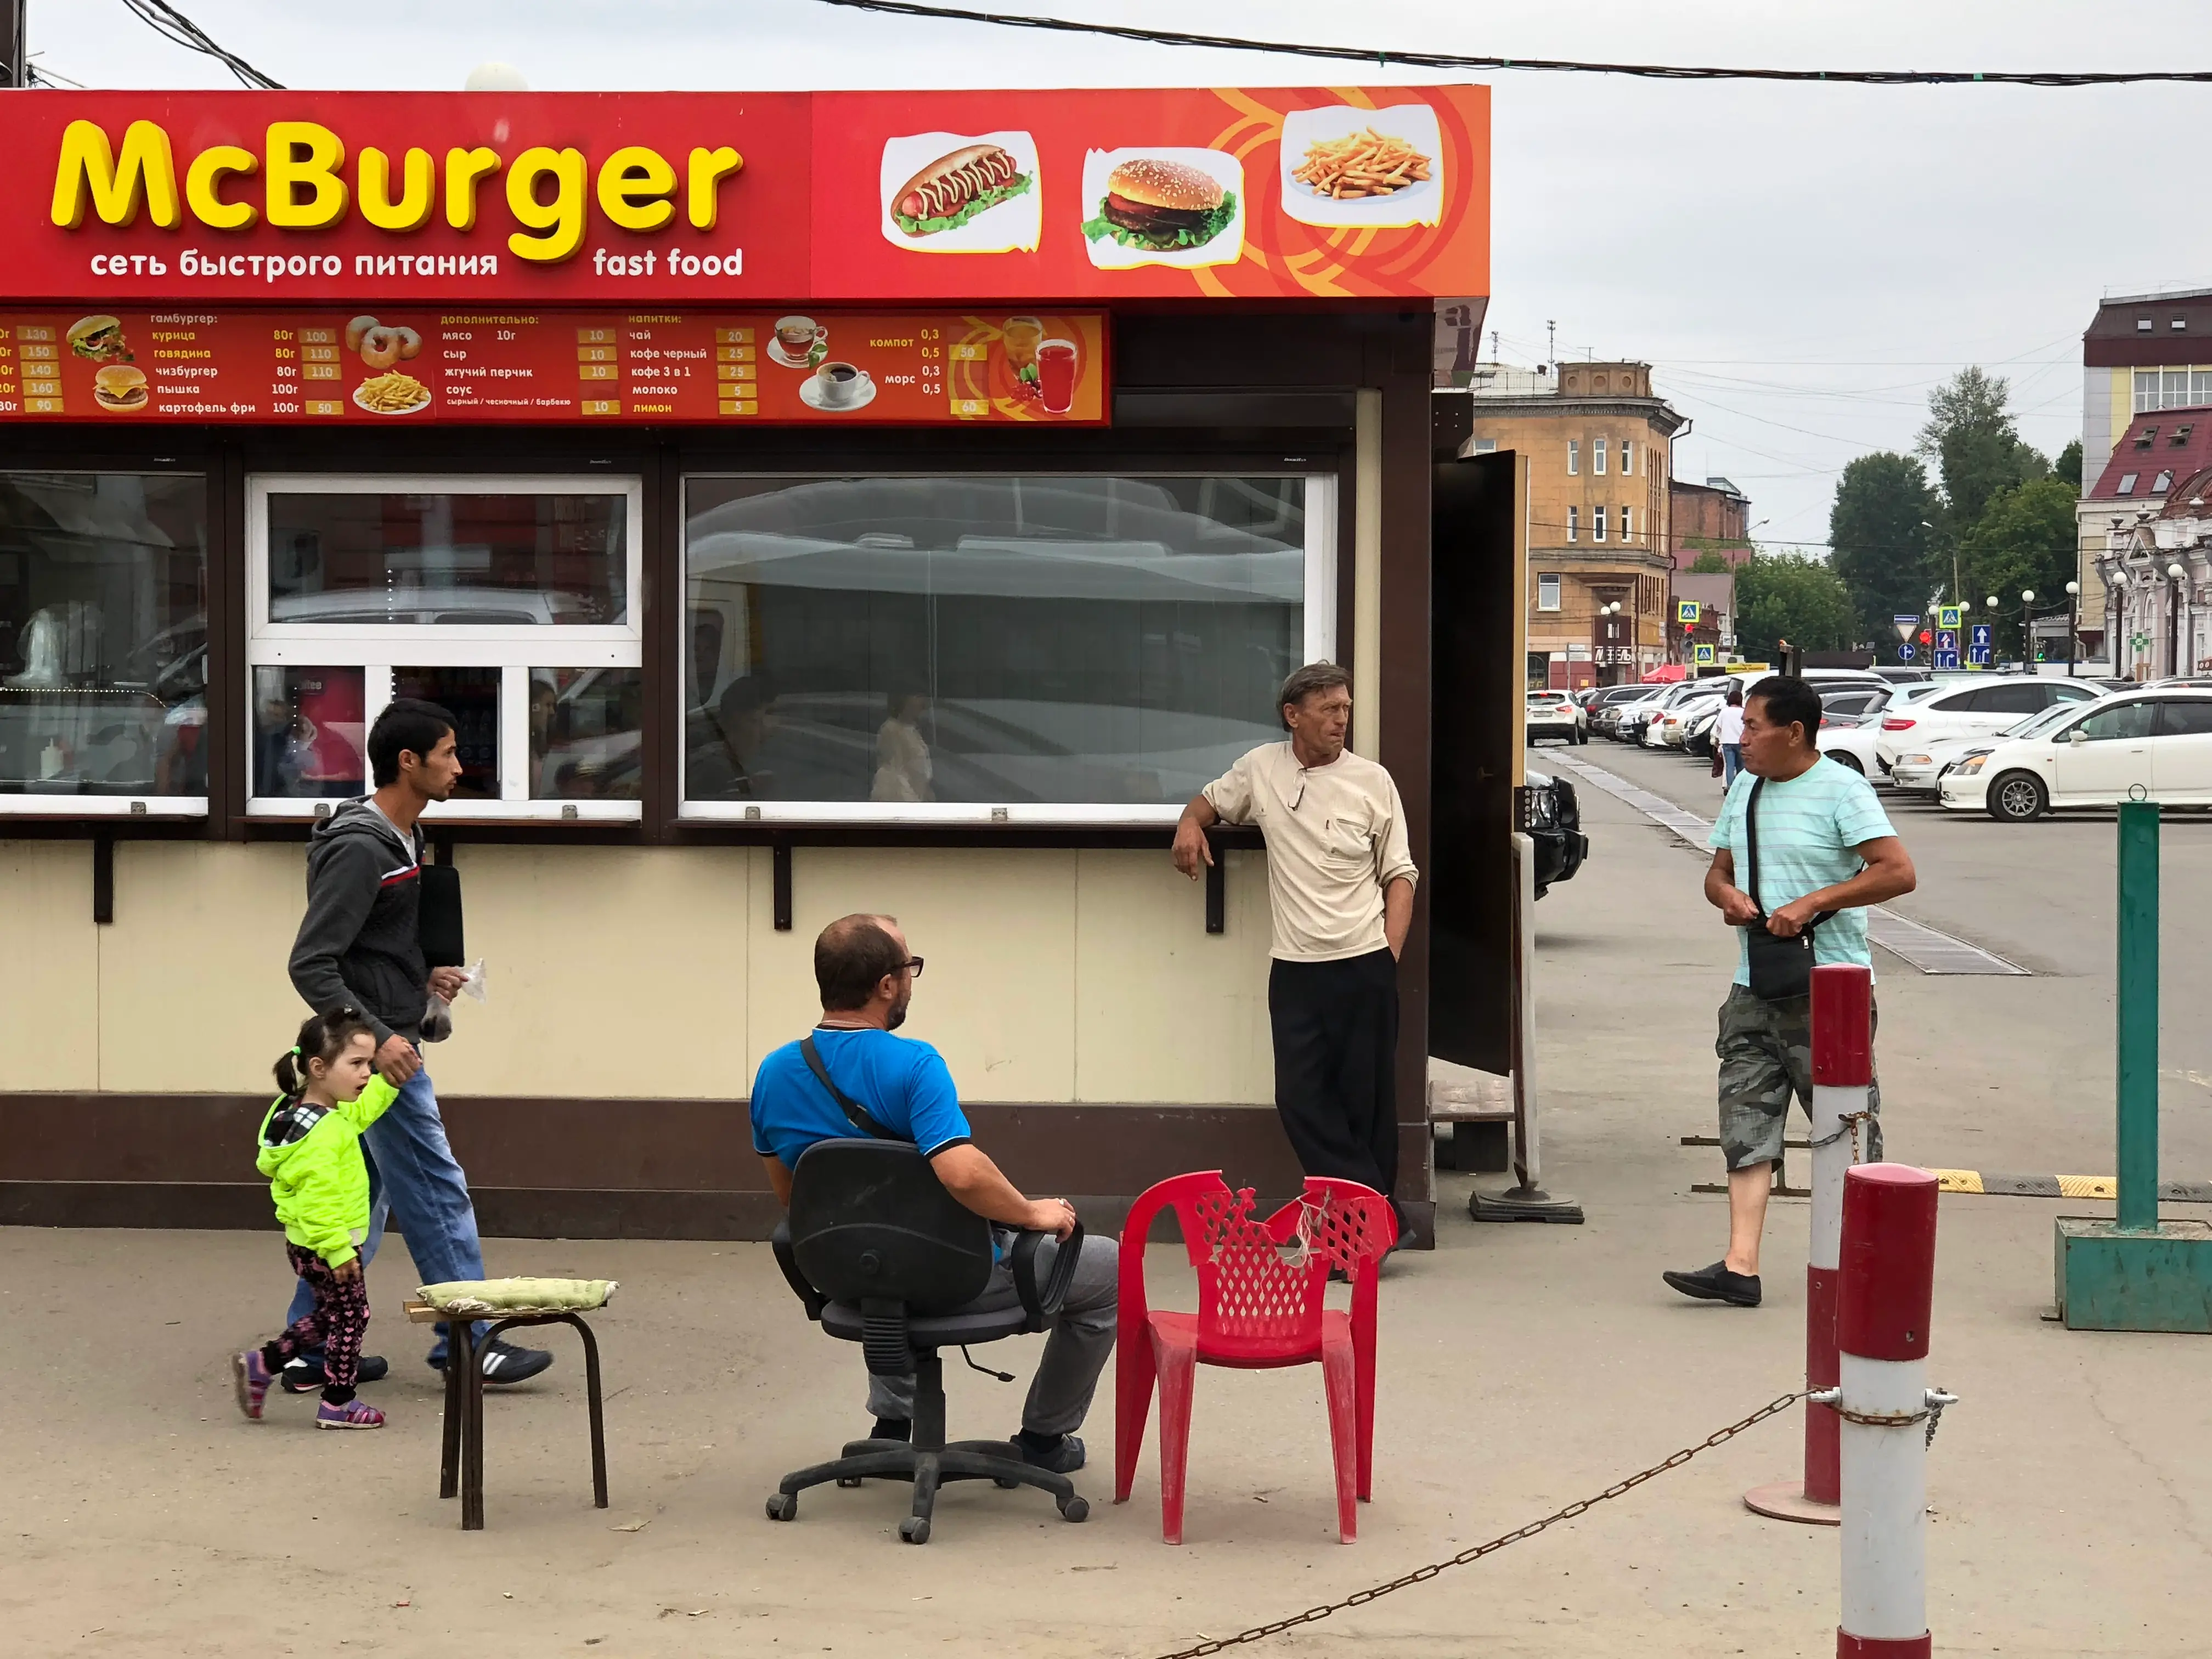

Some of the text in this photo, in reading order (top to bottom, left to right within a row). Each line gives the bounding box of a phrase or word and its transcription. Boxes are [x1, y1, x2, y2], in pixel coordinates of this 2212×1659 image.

[51, 119, 743, 263] McBurger
[91, 248, 498, 284] сеть быстрого питания
[593, 248, 743, 276] fast food
[150, 313, 218, 325] гамбургер:
[441, 316, 539, 325] дополнительно:
[629, 315, 682, 323] напитки:
[152, 330, 327, 342] курица 80г 100
[442, 330, 604, 341] мясо 10г 10
[629, 330, 743, 342] чай 20
[921, 329, 939, 341] 0,3
[870, 339, 915, 347] компот
[29, 347, 50, 357] 150
[154, 348, 332, 359] говядина 80г 110
[443, 349, 605, 361] сыр 10
[630, 348, 743, 360] кофе черный 25
[922, 347, 975, 359] 0,5 50
[30, 365, 51, 375] 140
[155, 365, 333, 378] чизбургер 80г 110
[445, 366, 606, 379] жгучий перчик 10
[631, 366, 744, 379] кофе 3 в 1 25
[922, 365, 940, 377] 0,3
[884, 375, 916, 386] морс
[31, 383, 53, 393] 160
[157, 383, 298, 394] пышка 100г
[446, 386, 472, 396] соус
[632, 386, 741, 396] молоко 5
[922, 383, 941, 395] 0,5
[159, 402, 332, 415] картофель фри 100г 50
[447, 398, 478, 406] сырный
[536, 398, 571, 407] барбекю
[594, 402, 608, 412] 10
[633, 404, 672, 413] лимон
[962, 402, 977, 411] 60
